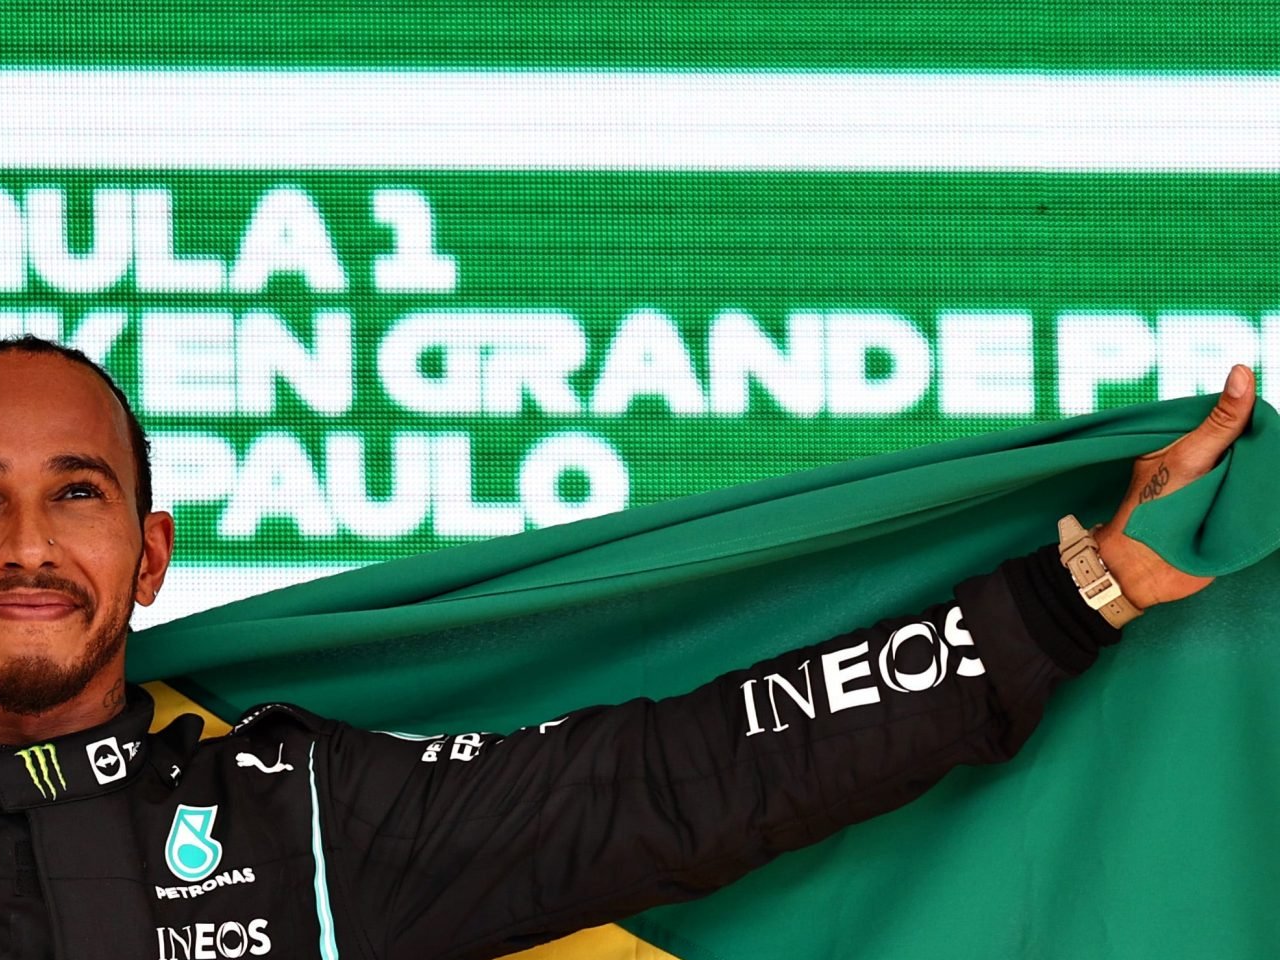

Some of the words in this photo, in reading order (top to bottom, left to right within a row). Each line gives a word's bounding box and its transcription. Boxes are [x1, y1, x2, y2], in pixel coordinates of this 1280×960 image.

[370, 188, 458, 294] 1
[377, 307, 1035, 418] GRANDE
[150, 430, 630, 538] PAULO
[1138, 461, 1170, 505] 1985
[155, 867, 256, 900] PETRONAS
